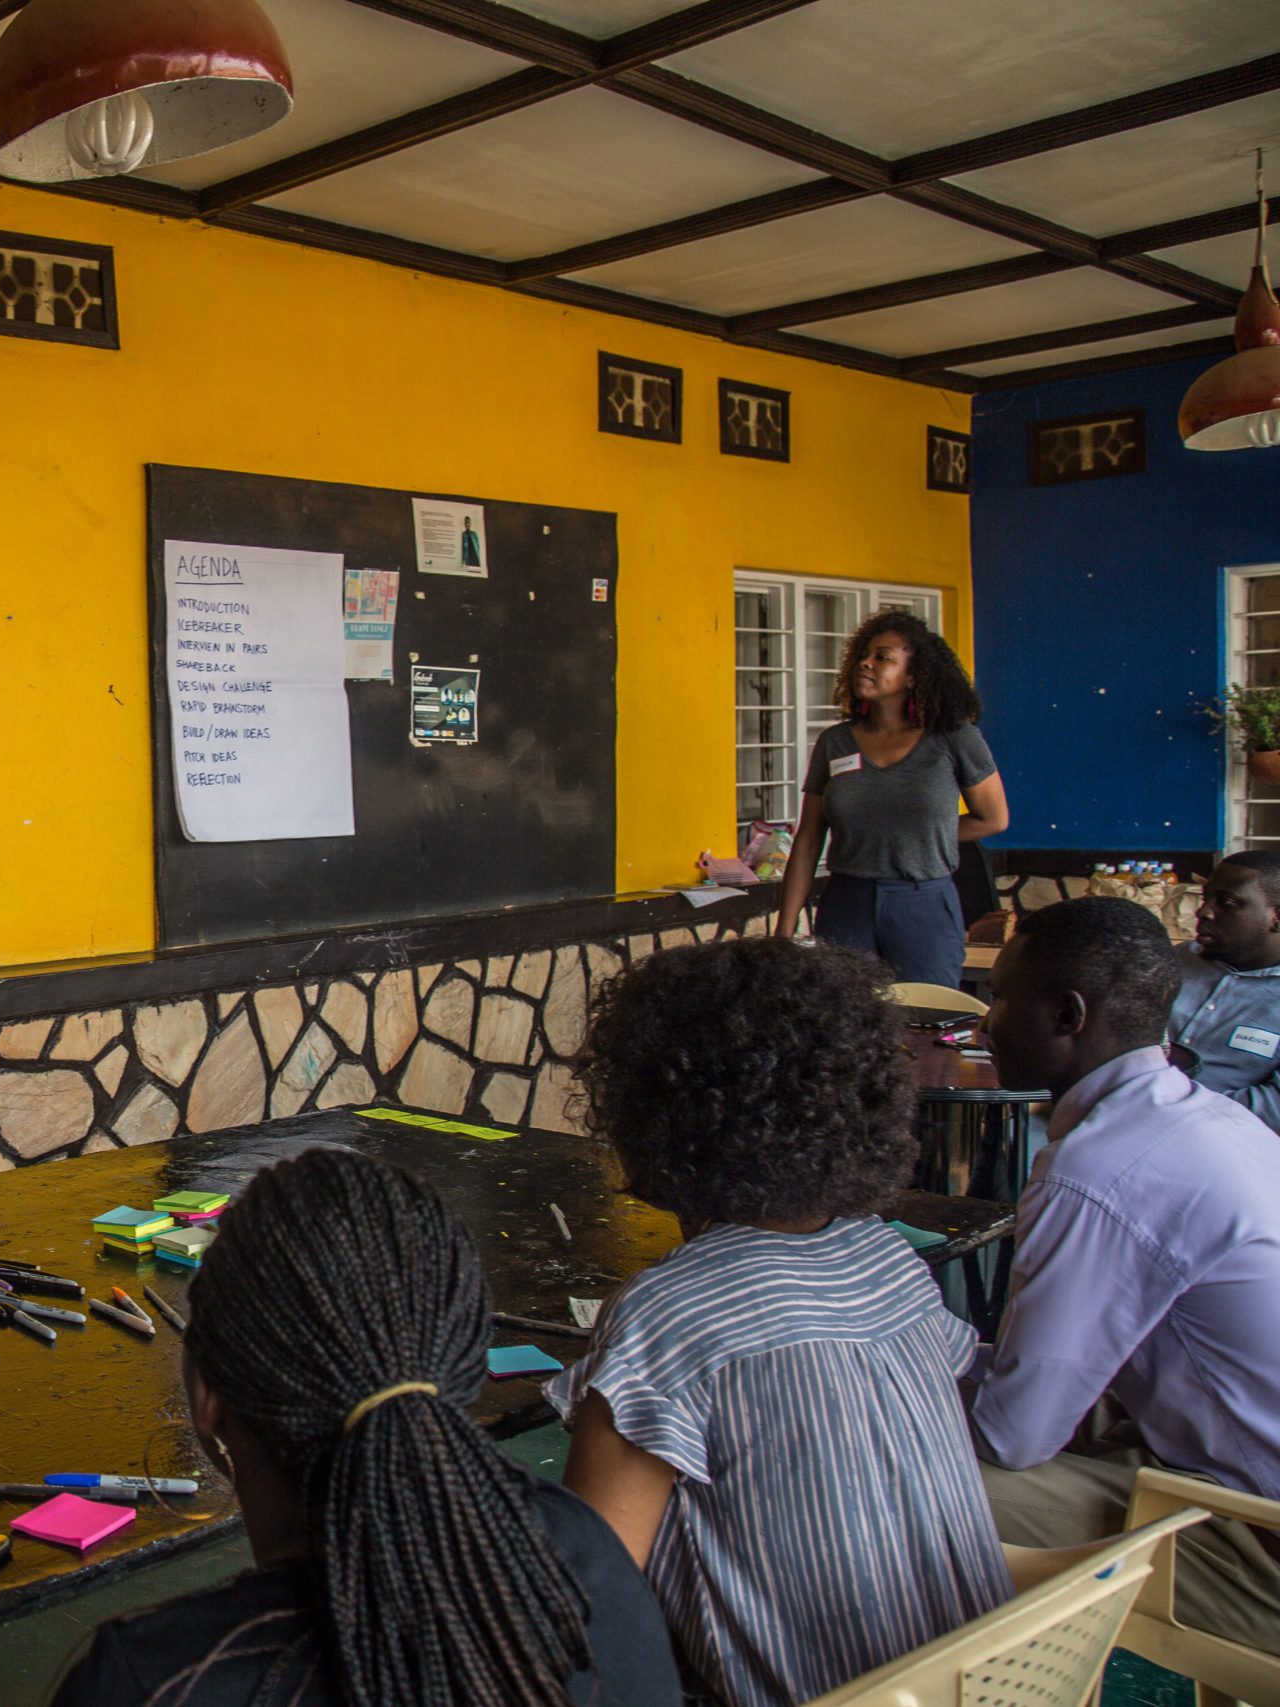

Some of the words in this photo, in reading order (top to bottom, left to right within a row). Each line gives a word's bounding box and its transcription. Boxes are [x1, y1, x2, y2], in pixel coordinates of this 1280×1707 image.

[177, 555, 242, 580] AGENDA
[177, 598, 250, 616] INTRODUCTION
[177, 618, 245, 635] ICEBREAKER
[225, 642, 236, 653] IN
[242, 643, 269, 654] PAIRS
[176, 660, 237, 673] SHAREBACK
[177, 680, 216, 693] DESIGN
[222, 681, 273, 693] CHALLENGE
[180, 700, 207, 712] RAPID
[212, 702, 266, 715] BRAINSTORM
[243, 727, 271, 739] IDEAS
[183, 750, 206, 763] PITCH
[211, 751, 238, 763] IDEAS
